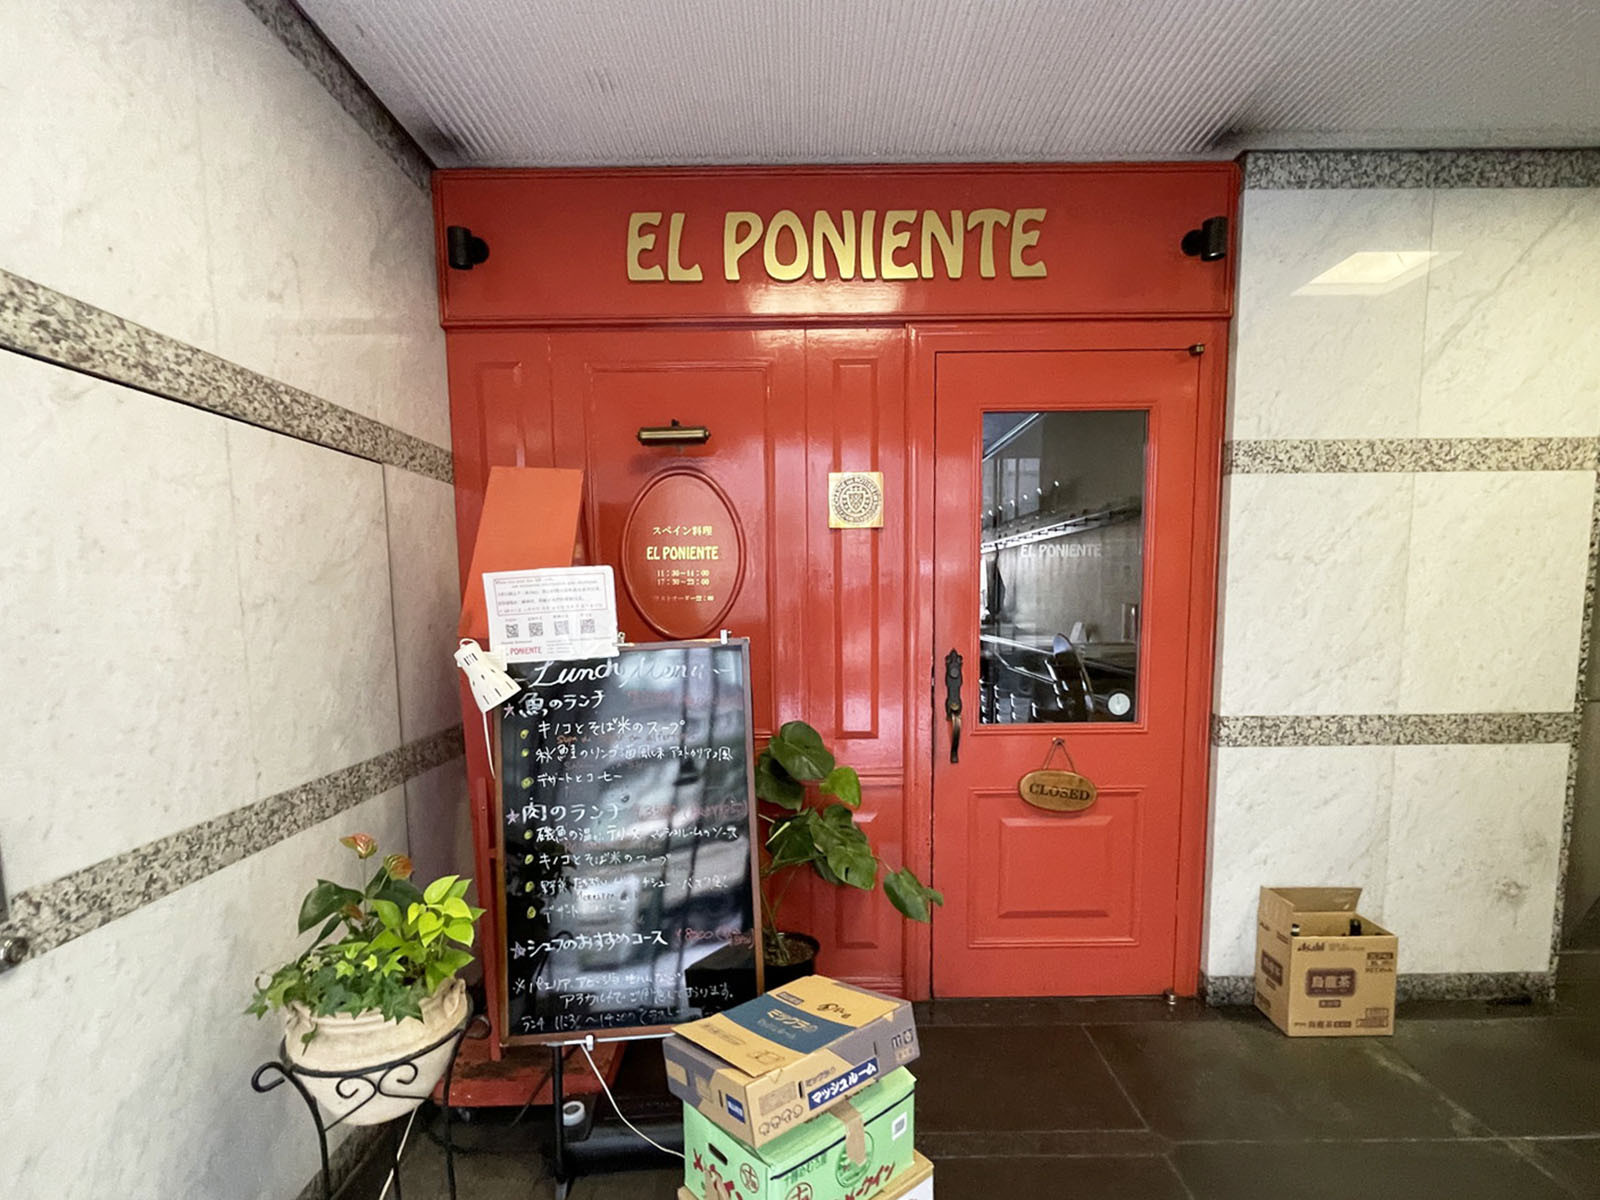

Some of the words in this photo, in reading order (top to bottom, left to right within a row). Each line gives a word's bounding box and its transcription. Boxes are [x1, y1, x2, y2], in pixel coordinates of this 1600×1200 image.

[627, 212, 703, 282] EL
[724, 208, 1048, 281] PONIENTE
[652, 525, 713, 536] スペイン料理
[646, 546, 660, 560] EL
[662, 545, 719, 560] PONIENTE
[1021, 544, 1033, 558] EL
[1038, 544, 1102, 558] PONIENTE
[509, 646, 542, 656] PONIENTE
[528, 657, 621, 688] Lunch
[519, 690, 605, 718] 魚のランチ
[1029, 783, 1091, 801] CLOSED
[521, 797, 618, 824] 肉のランチ
[527, 930, 668, 958] シェフのおすすめコース
[811, 1062, 877, 1104] マッシュルーム
